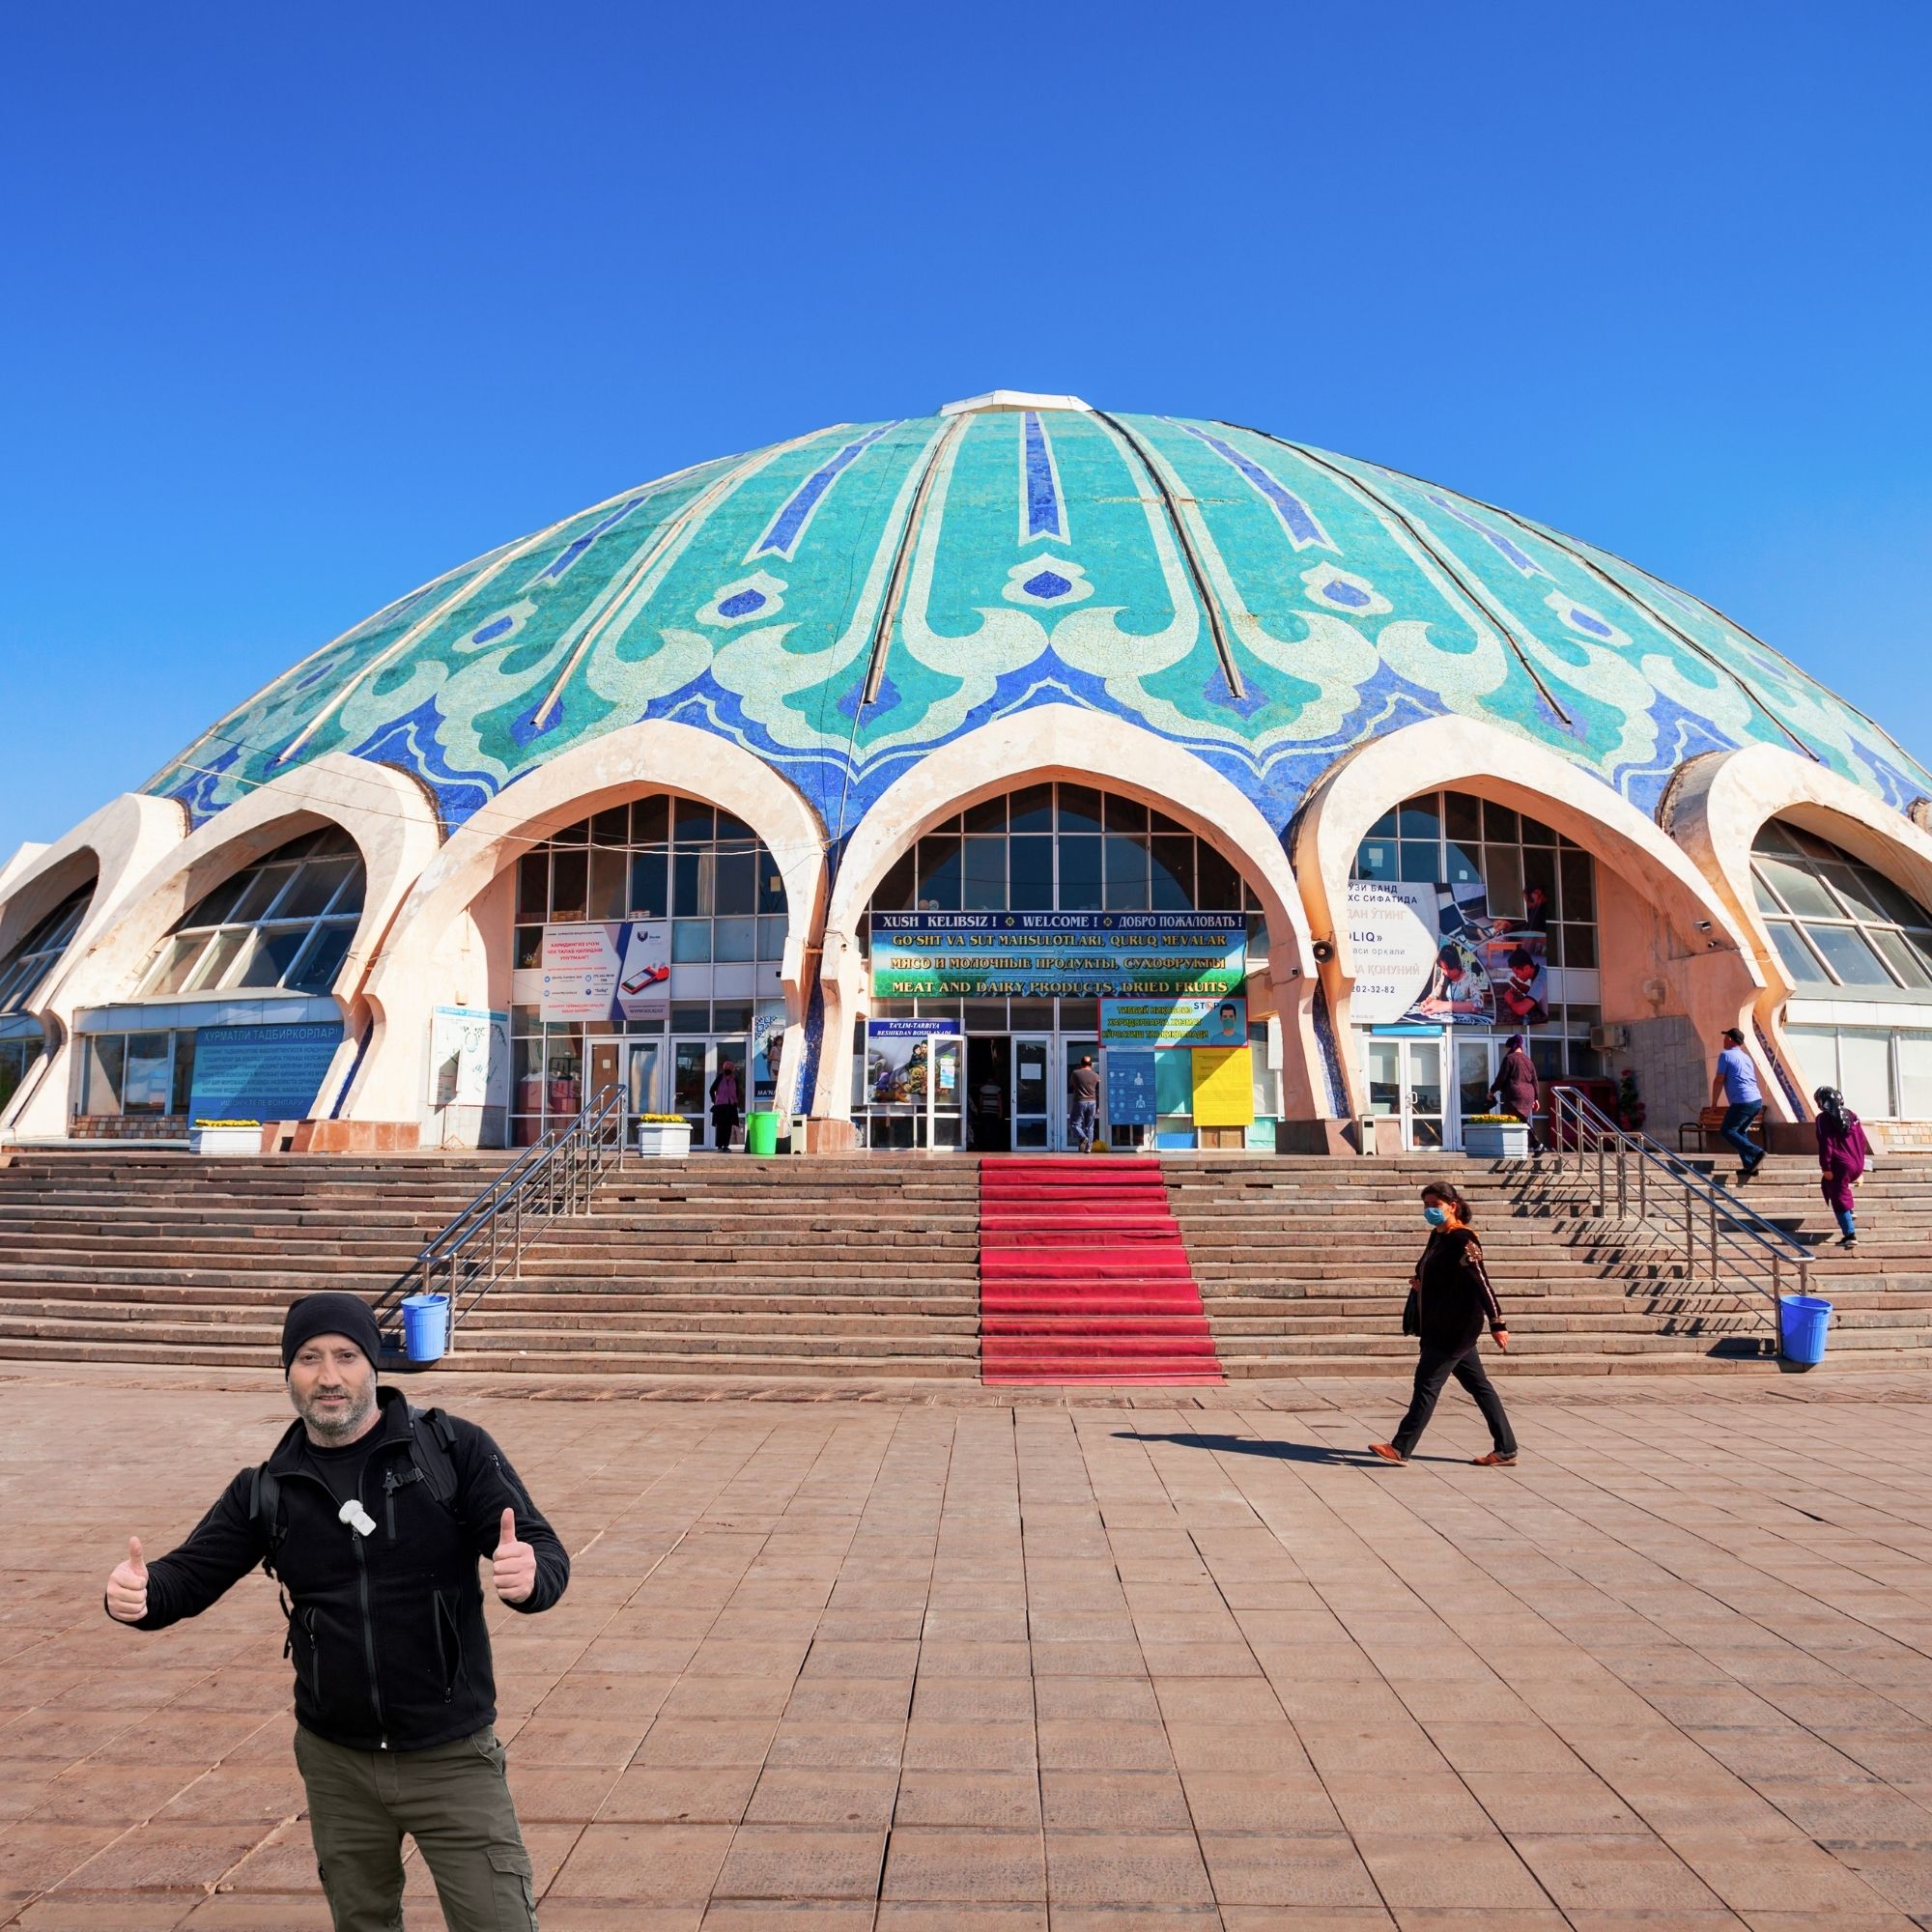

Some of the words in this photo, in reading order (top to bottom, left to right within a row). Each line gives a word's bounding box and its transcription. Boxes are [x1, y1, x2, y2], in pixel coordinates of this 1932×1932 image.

[1371, 884, 1398, 894] БАНД
[1363, 895, 1418, 904] СИФАТИДА
[1371, 908, 1406, 921] ЎТИНГ
[883, 916, 919, 927] XUSH
[927, 916, 988, 927] KELIBSIZ
[1023, 916, 1090, 927] WELCOME
[1118, 916, 1156, 928] ДОБРО
[1159, 916, 1236, 927] ПОЖАЛОВАТЬ
[946, 935, 965, 946] VA
[969, 935, 994, 946] SUT
[997, 935, 1105, 948] MAHSULOTLARI,
[1111, 935, 1158, 948] QURUQ
[1162, 935, 1227, 946] MEVALAR
[1349, 931, 1383, 943] LIQ»
[891, 957, 931, 969] МЯСО
[934, 957, 946, 969] И
[949, 957, 1032, 969] МОЛОЧНЫЕ
[1036, 957, 1119, 970] ПРОДУКТЫ,
[1122, 957, 1226, 969] СУХОФРУКТЫ
[892, 981, 934, 993] MEAT
[938, 981, 971, 993] AND
[977, 981, 1025, 993] DAIRY
[1030, 981, 1116, 994] PRODUCTS,
[1122, 981, 1170, 993] DRIED
[1176, 981, 1228, 993] FRUITS
[1117, 1005, 1149, 1014] ТИББИЙ
